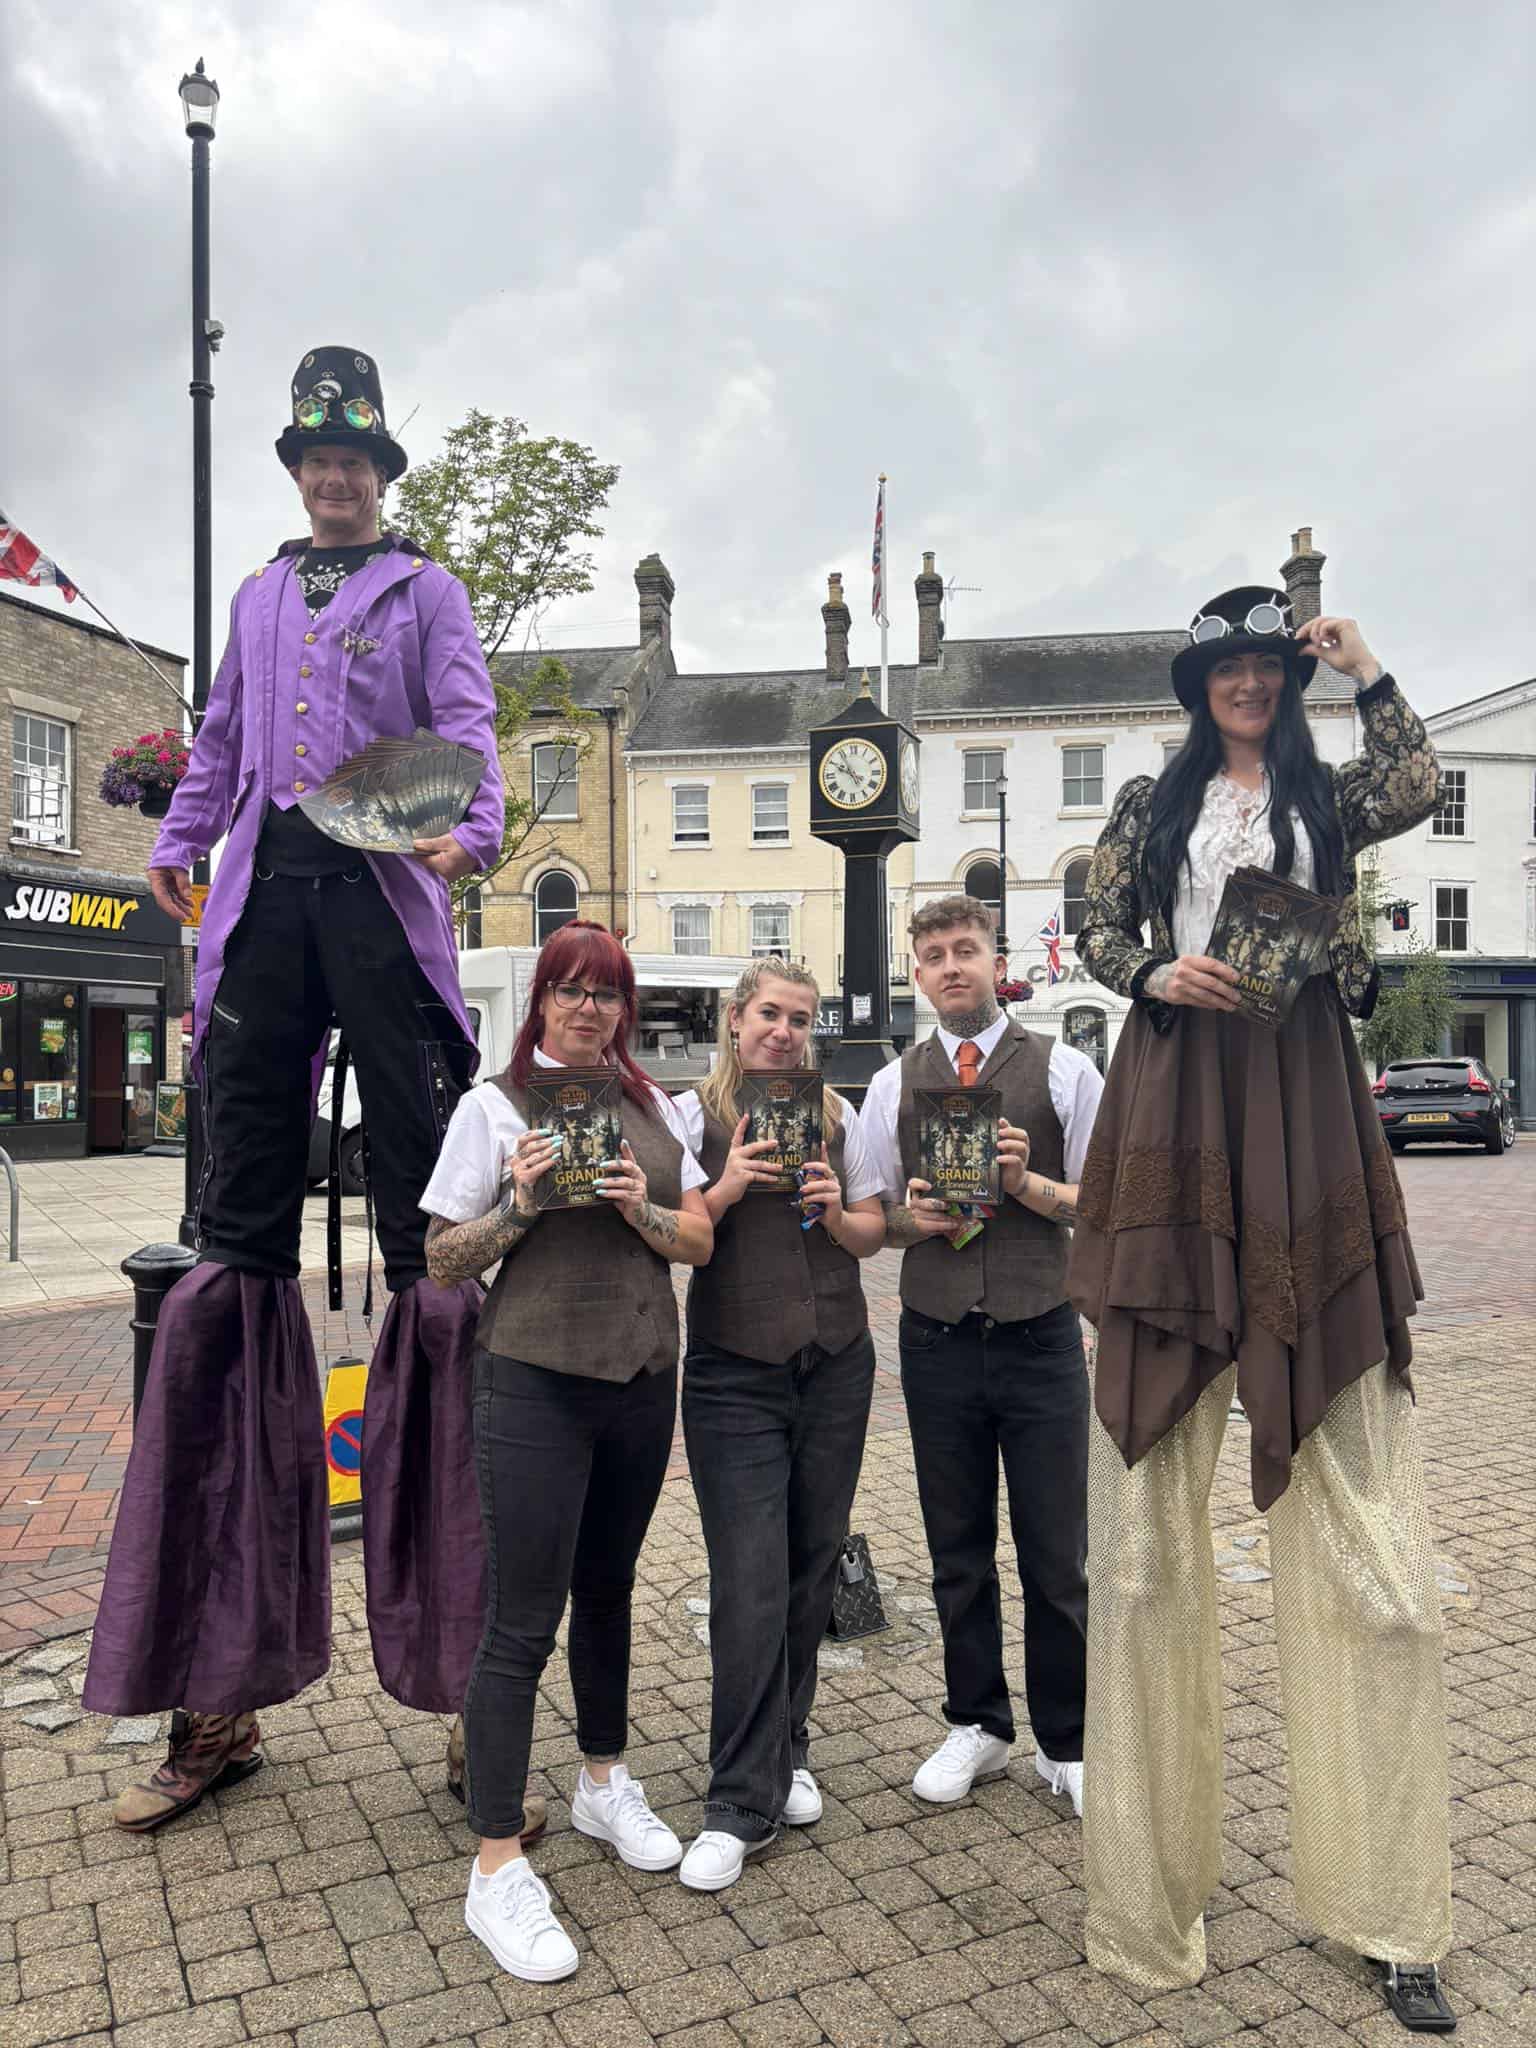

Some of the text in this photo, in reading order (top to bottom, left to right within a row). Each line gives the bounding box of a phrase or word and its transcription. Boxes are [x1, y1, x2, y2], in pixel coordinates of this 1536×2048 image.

[5, 886, 139, 930] SUBWAY
[555, 1167, 605, 1185] GRAND
[936, 1168, 981, 1181] GRAND
